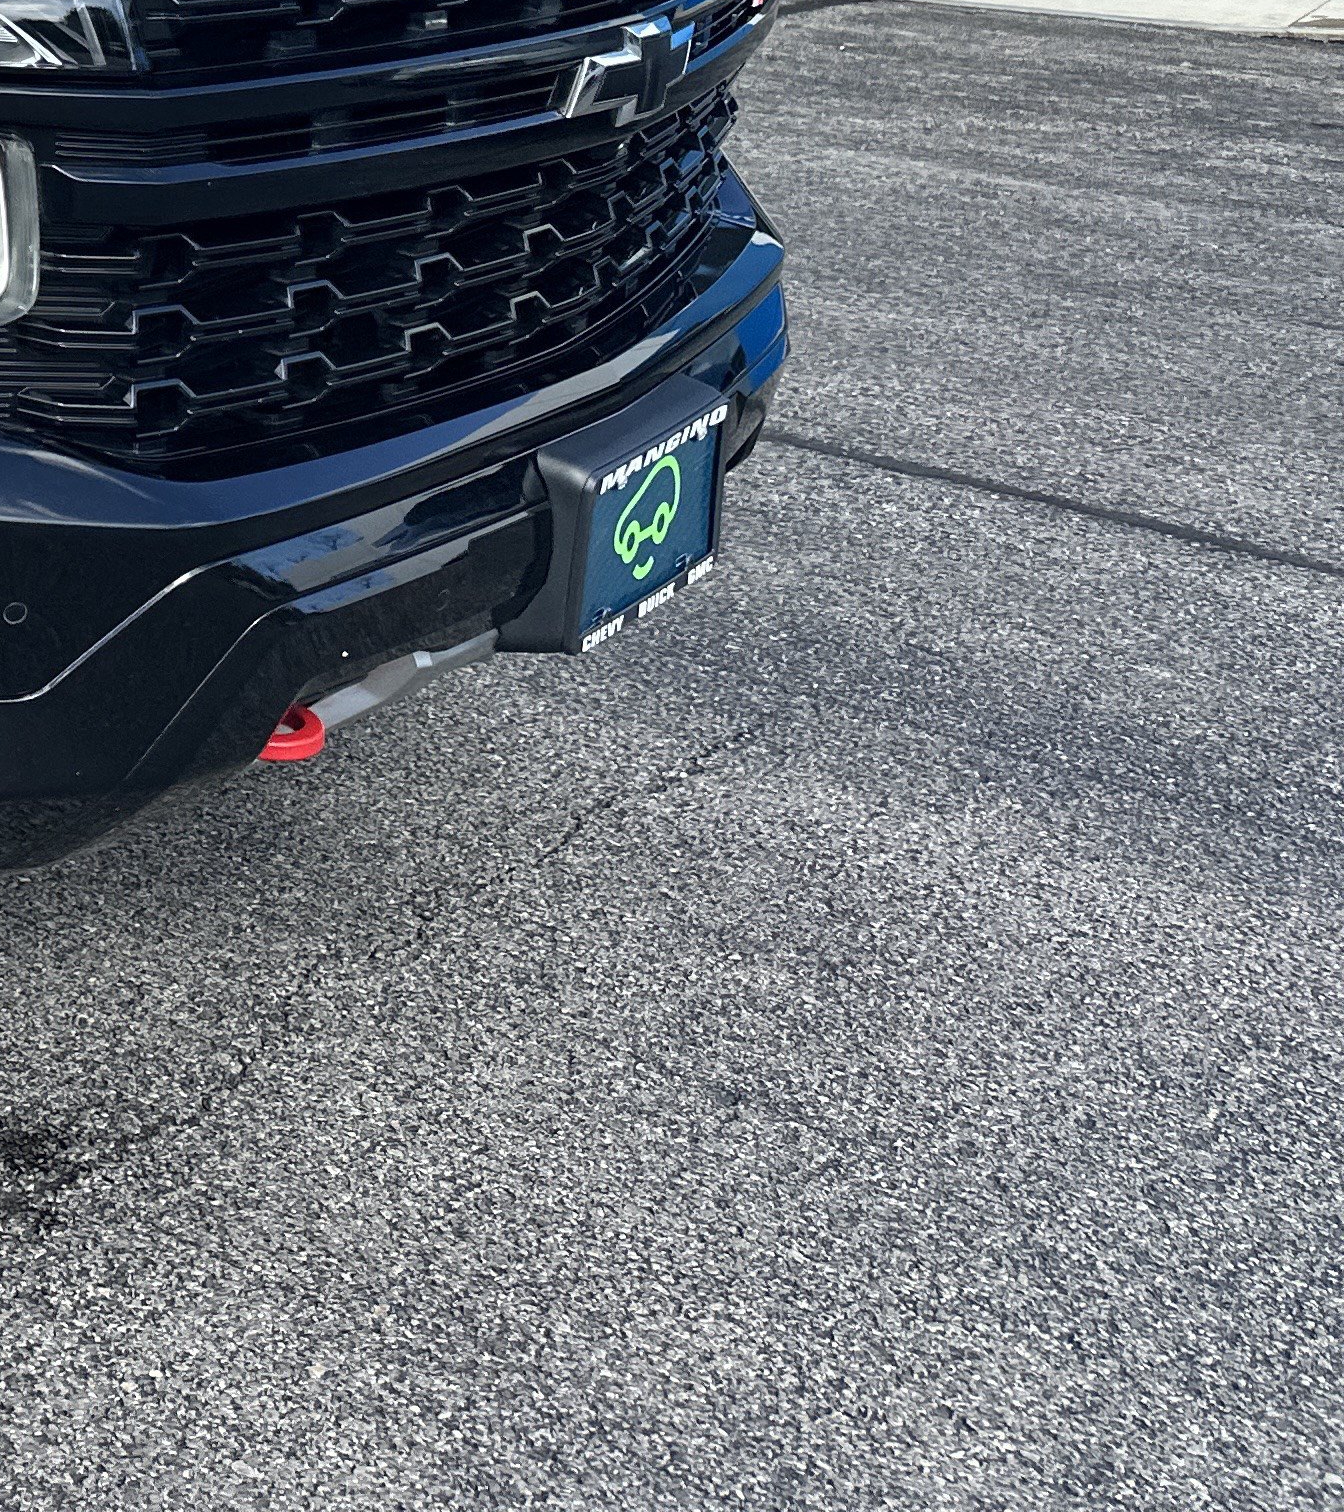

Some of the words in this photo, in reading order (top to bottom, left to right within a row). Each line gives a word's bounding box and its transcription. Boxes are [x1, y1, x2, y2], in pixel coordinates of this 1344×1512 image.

[599, 403, 729, 496] MANGINO
[581, 615, 625, 653] CHEVY
[637, 582, 676, 618] BUICK
[687, 555, 714, 585] GMC
